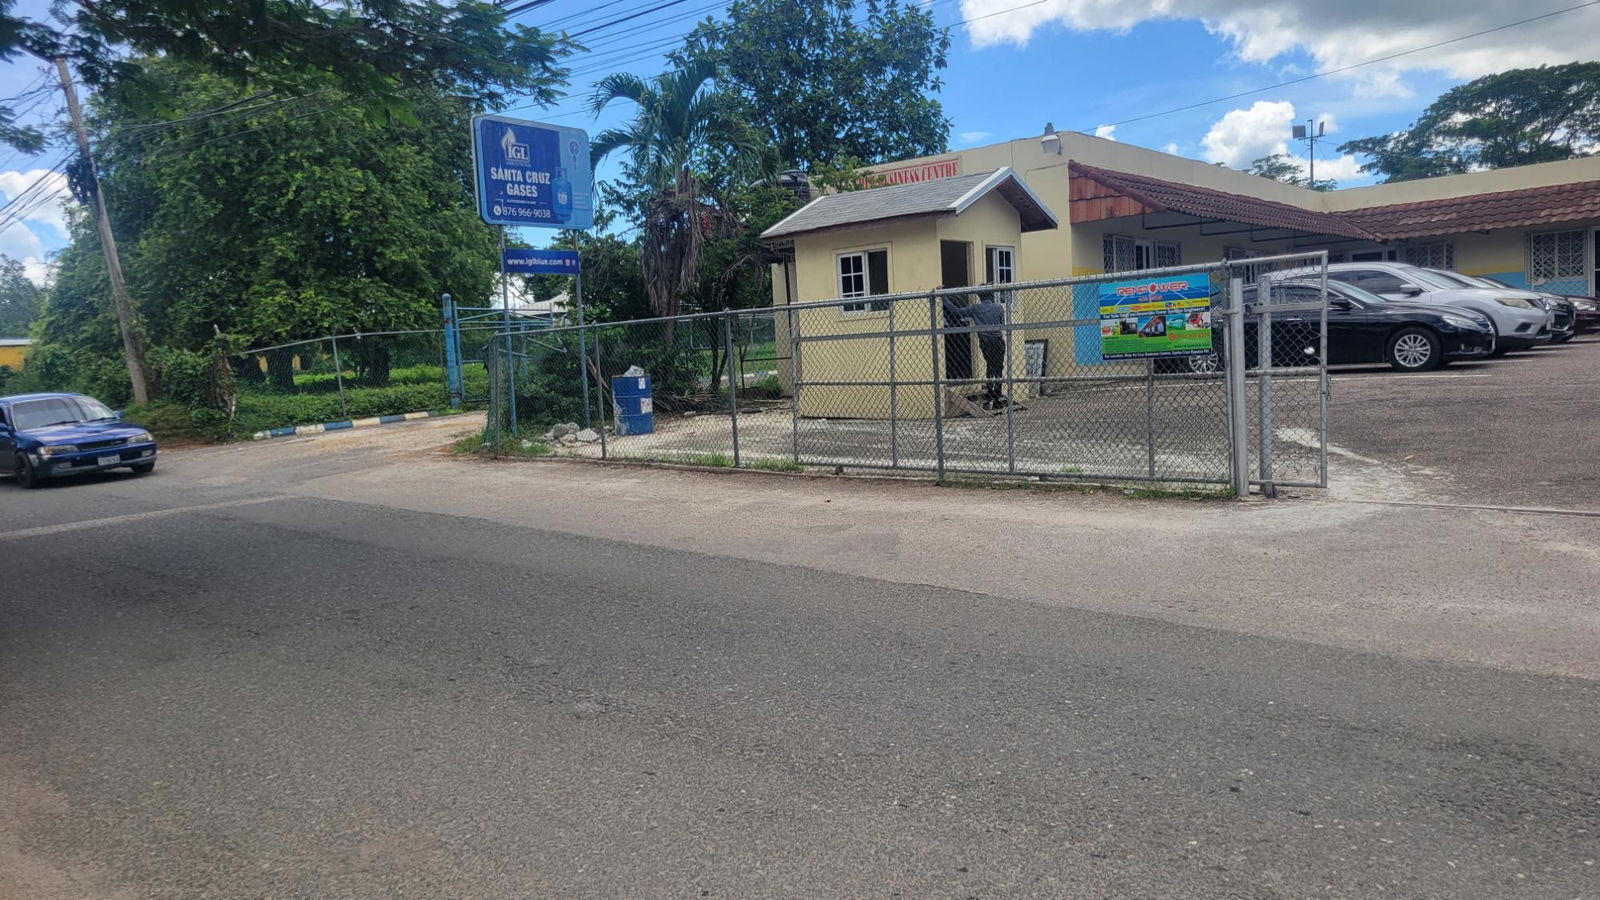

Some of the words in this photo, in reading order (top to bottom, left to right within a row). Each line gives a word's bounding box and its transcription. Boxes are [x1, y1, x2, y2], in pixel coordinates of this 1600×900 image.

[507, 146, 529, 160] IGL
[490, 166, 523, 182] SANTA
[525, 170, 551, 185] CRUZ
[921, 162, 957, 181] CENTRE
[506, 183, 538, 198] GASES
[502, 207, 517, 216] 876
[518, 208, 551, 219] 966-9038
